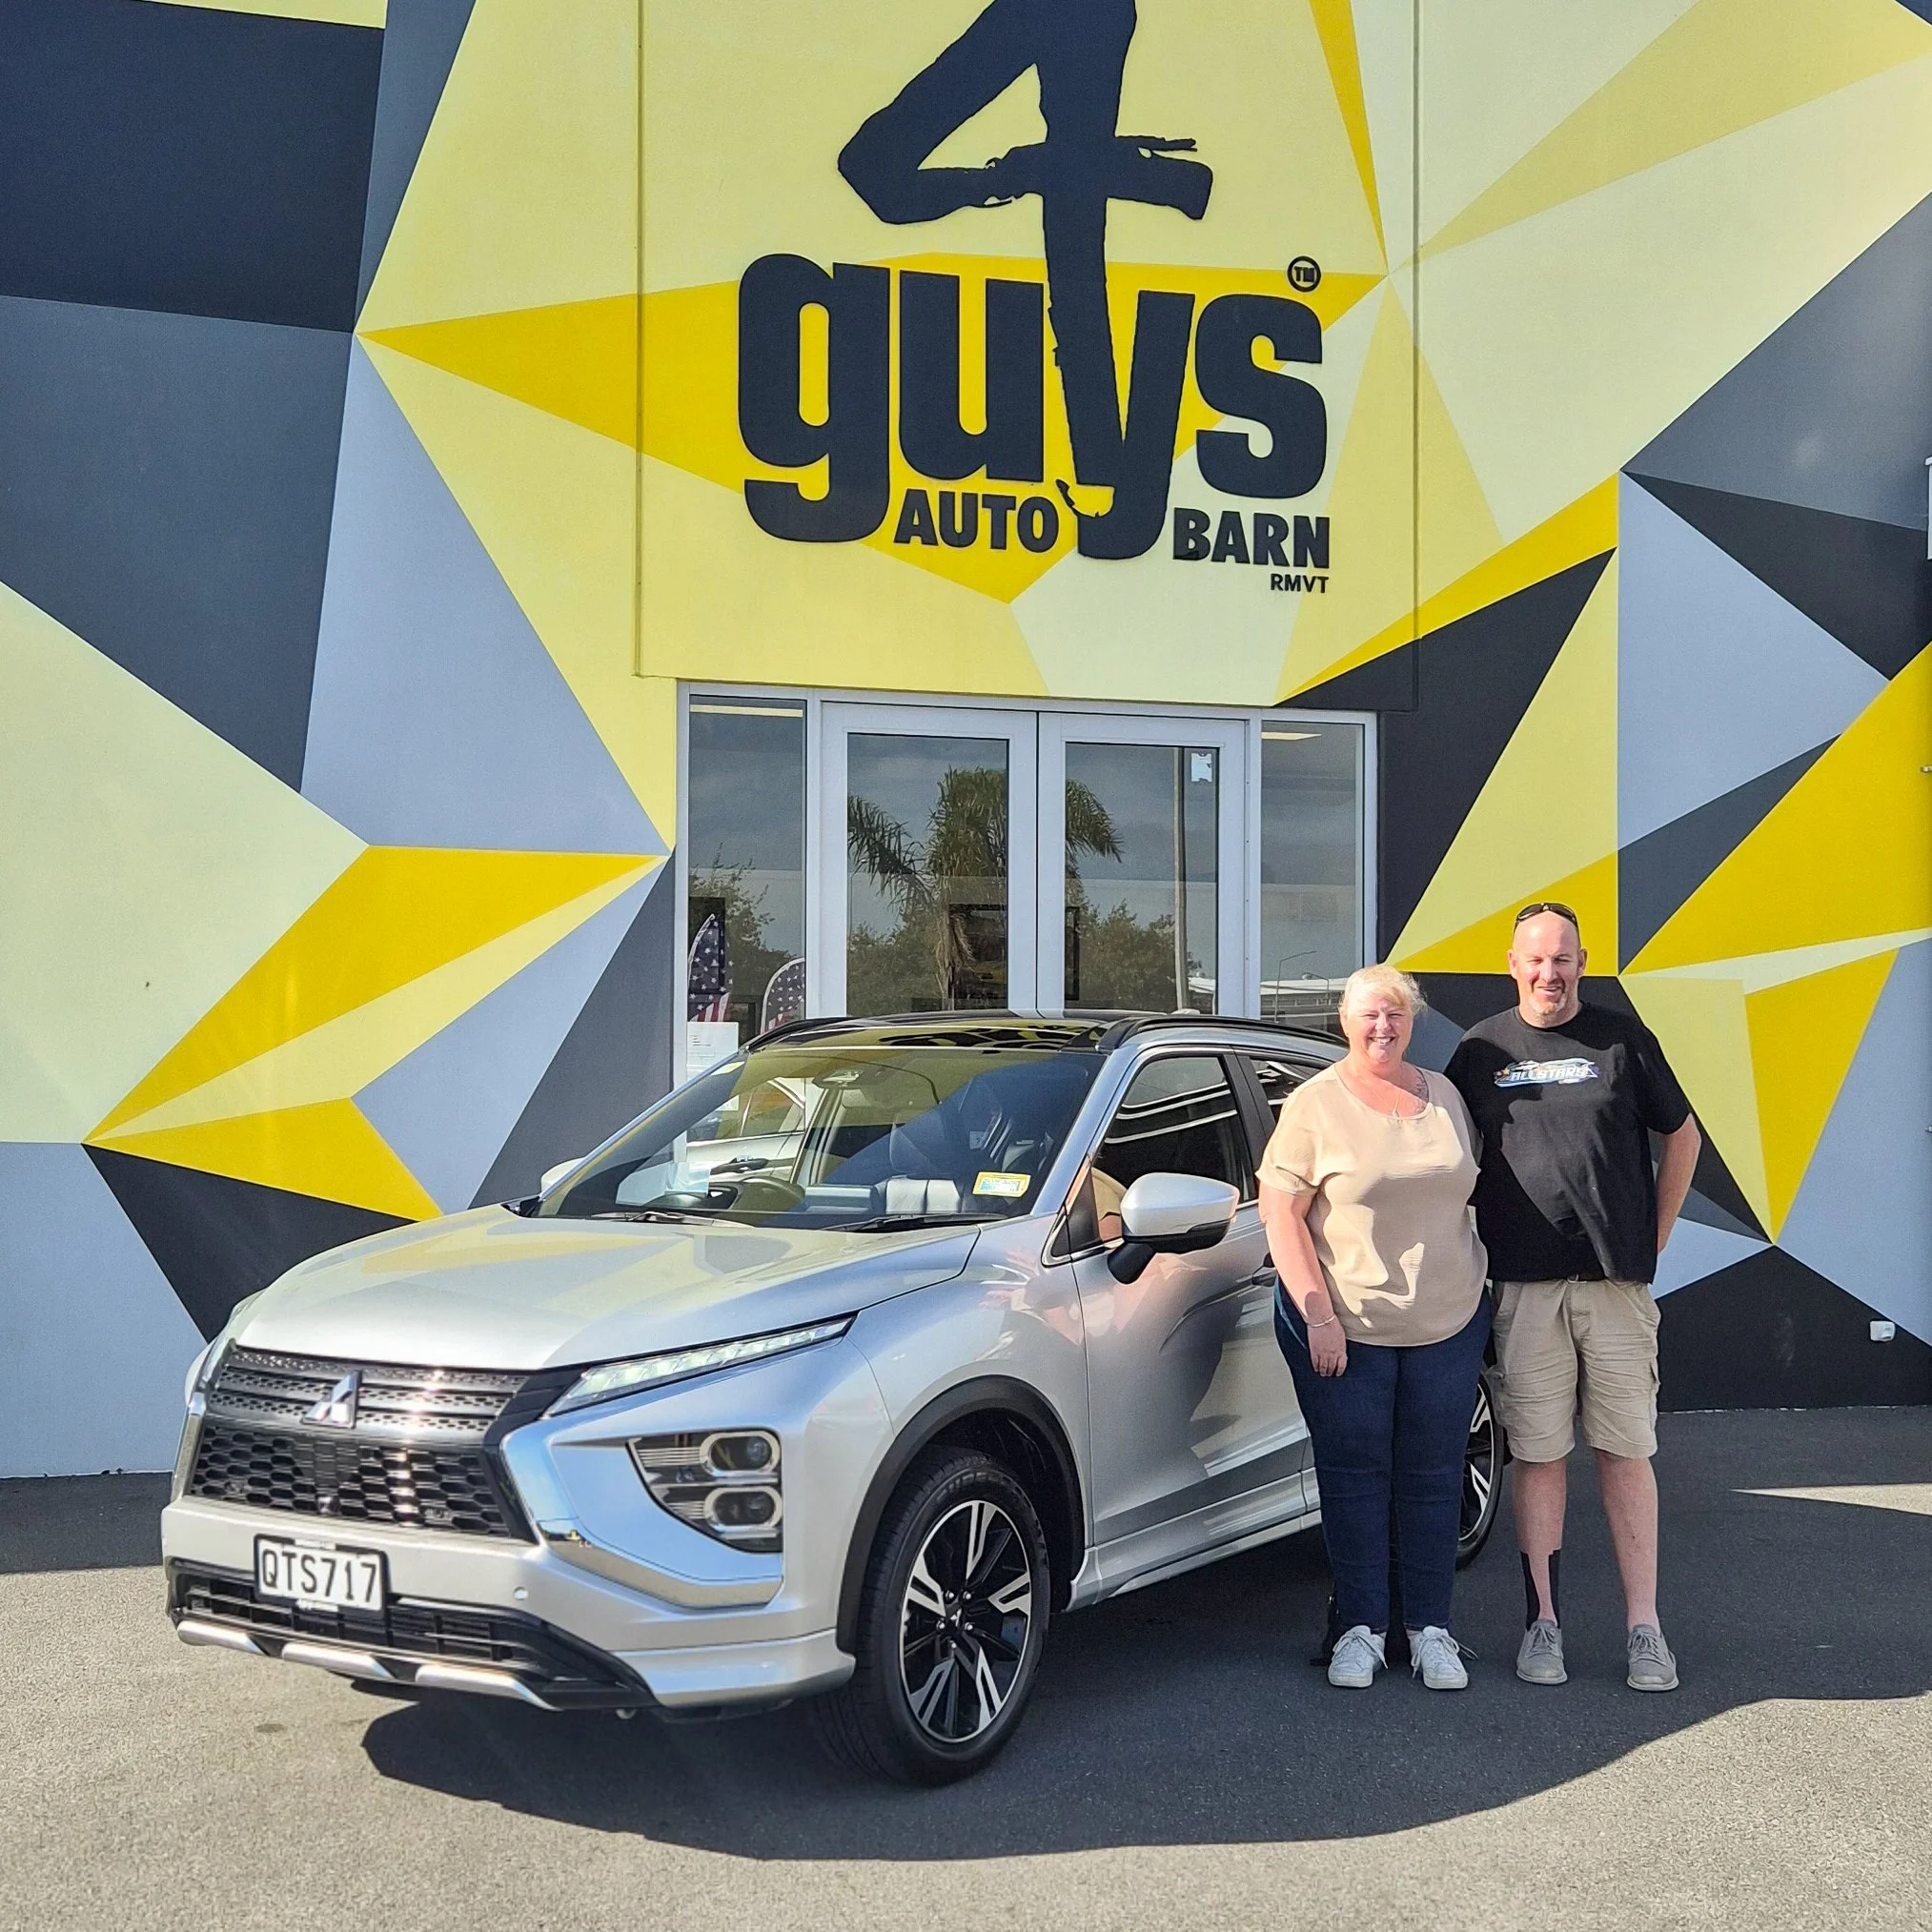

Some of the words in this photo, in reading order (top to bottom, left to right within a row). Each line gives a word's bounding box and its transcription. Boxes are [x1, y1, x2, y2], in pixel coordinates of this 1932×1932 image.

[838, 0, 1212, 276] 4
[738, 254, 1328, 561] guys
[893, 488, 1060, 554] AUTO
[1172, 507, 1331, 569] BARN
[1270, 573, 1330, 594] RMVT
[261, 1548, 376, 1603] QTS717
